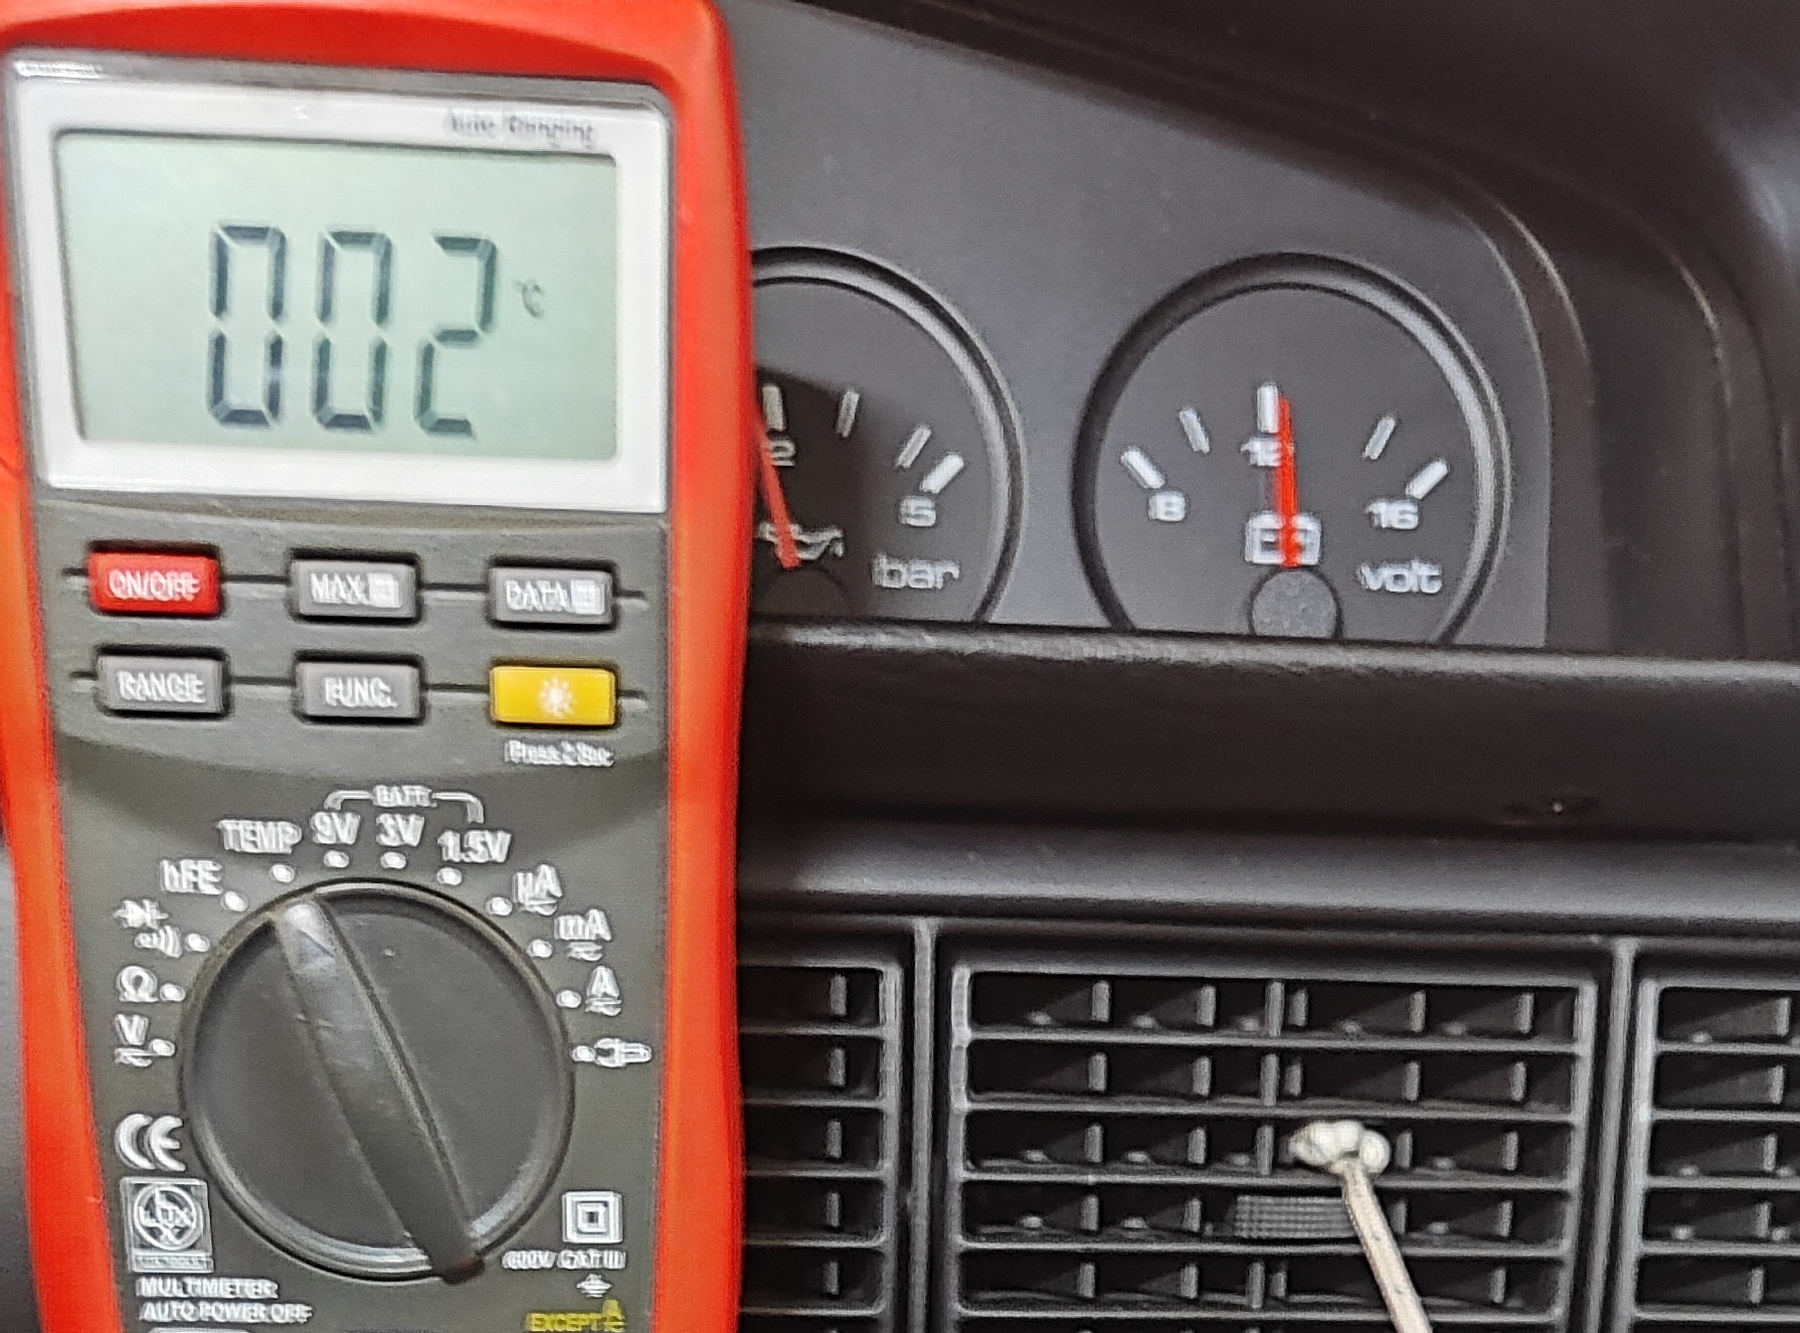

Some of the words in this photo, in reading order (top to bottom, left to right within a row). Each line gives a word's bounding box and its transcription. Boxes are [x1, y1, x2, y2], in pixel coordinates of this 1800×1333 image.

[206, 222, 500, 440] 002
[900, 496, 936, 527] 5
[1149, 490, 1188, 523] 8
[1364, 500, 1419, 530] 16
[108, 568, 201, 602] ON/OFF
[309, 571, 366, 603] MAX
[872, 552, 961, 590] bar
[1356, 560, 1443, 595] volt
[114, 671, 206, 704] RANGE
[216, 819, 302, 855] TEMP
[311, 811, 361, 845] 9V
[375, 813, 425, 847] 3V
[436, 830, 512, 864] 1.5V
[159, 859, 223, 896] hFE
[553, 908, 612, 942] mA
[586, 965, 619, 998] A
[115, 1013, 149, 1045] V
[135, 1277, 279, 1299] MULTIMETER
[139, 1300, 200, 1323] AUTO
[199, 1301, 268, 1324] POWER
[270, 1302, 314, 1325] OFF
